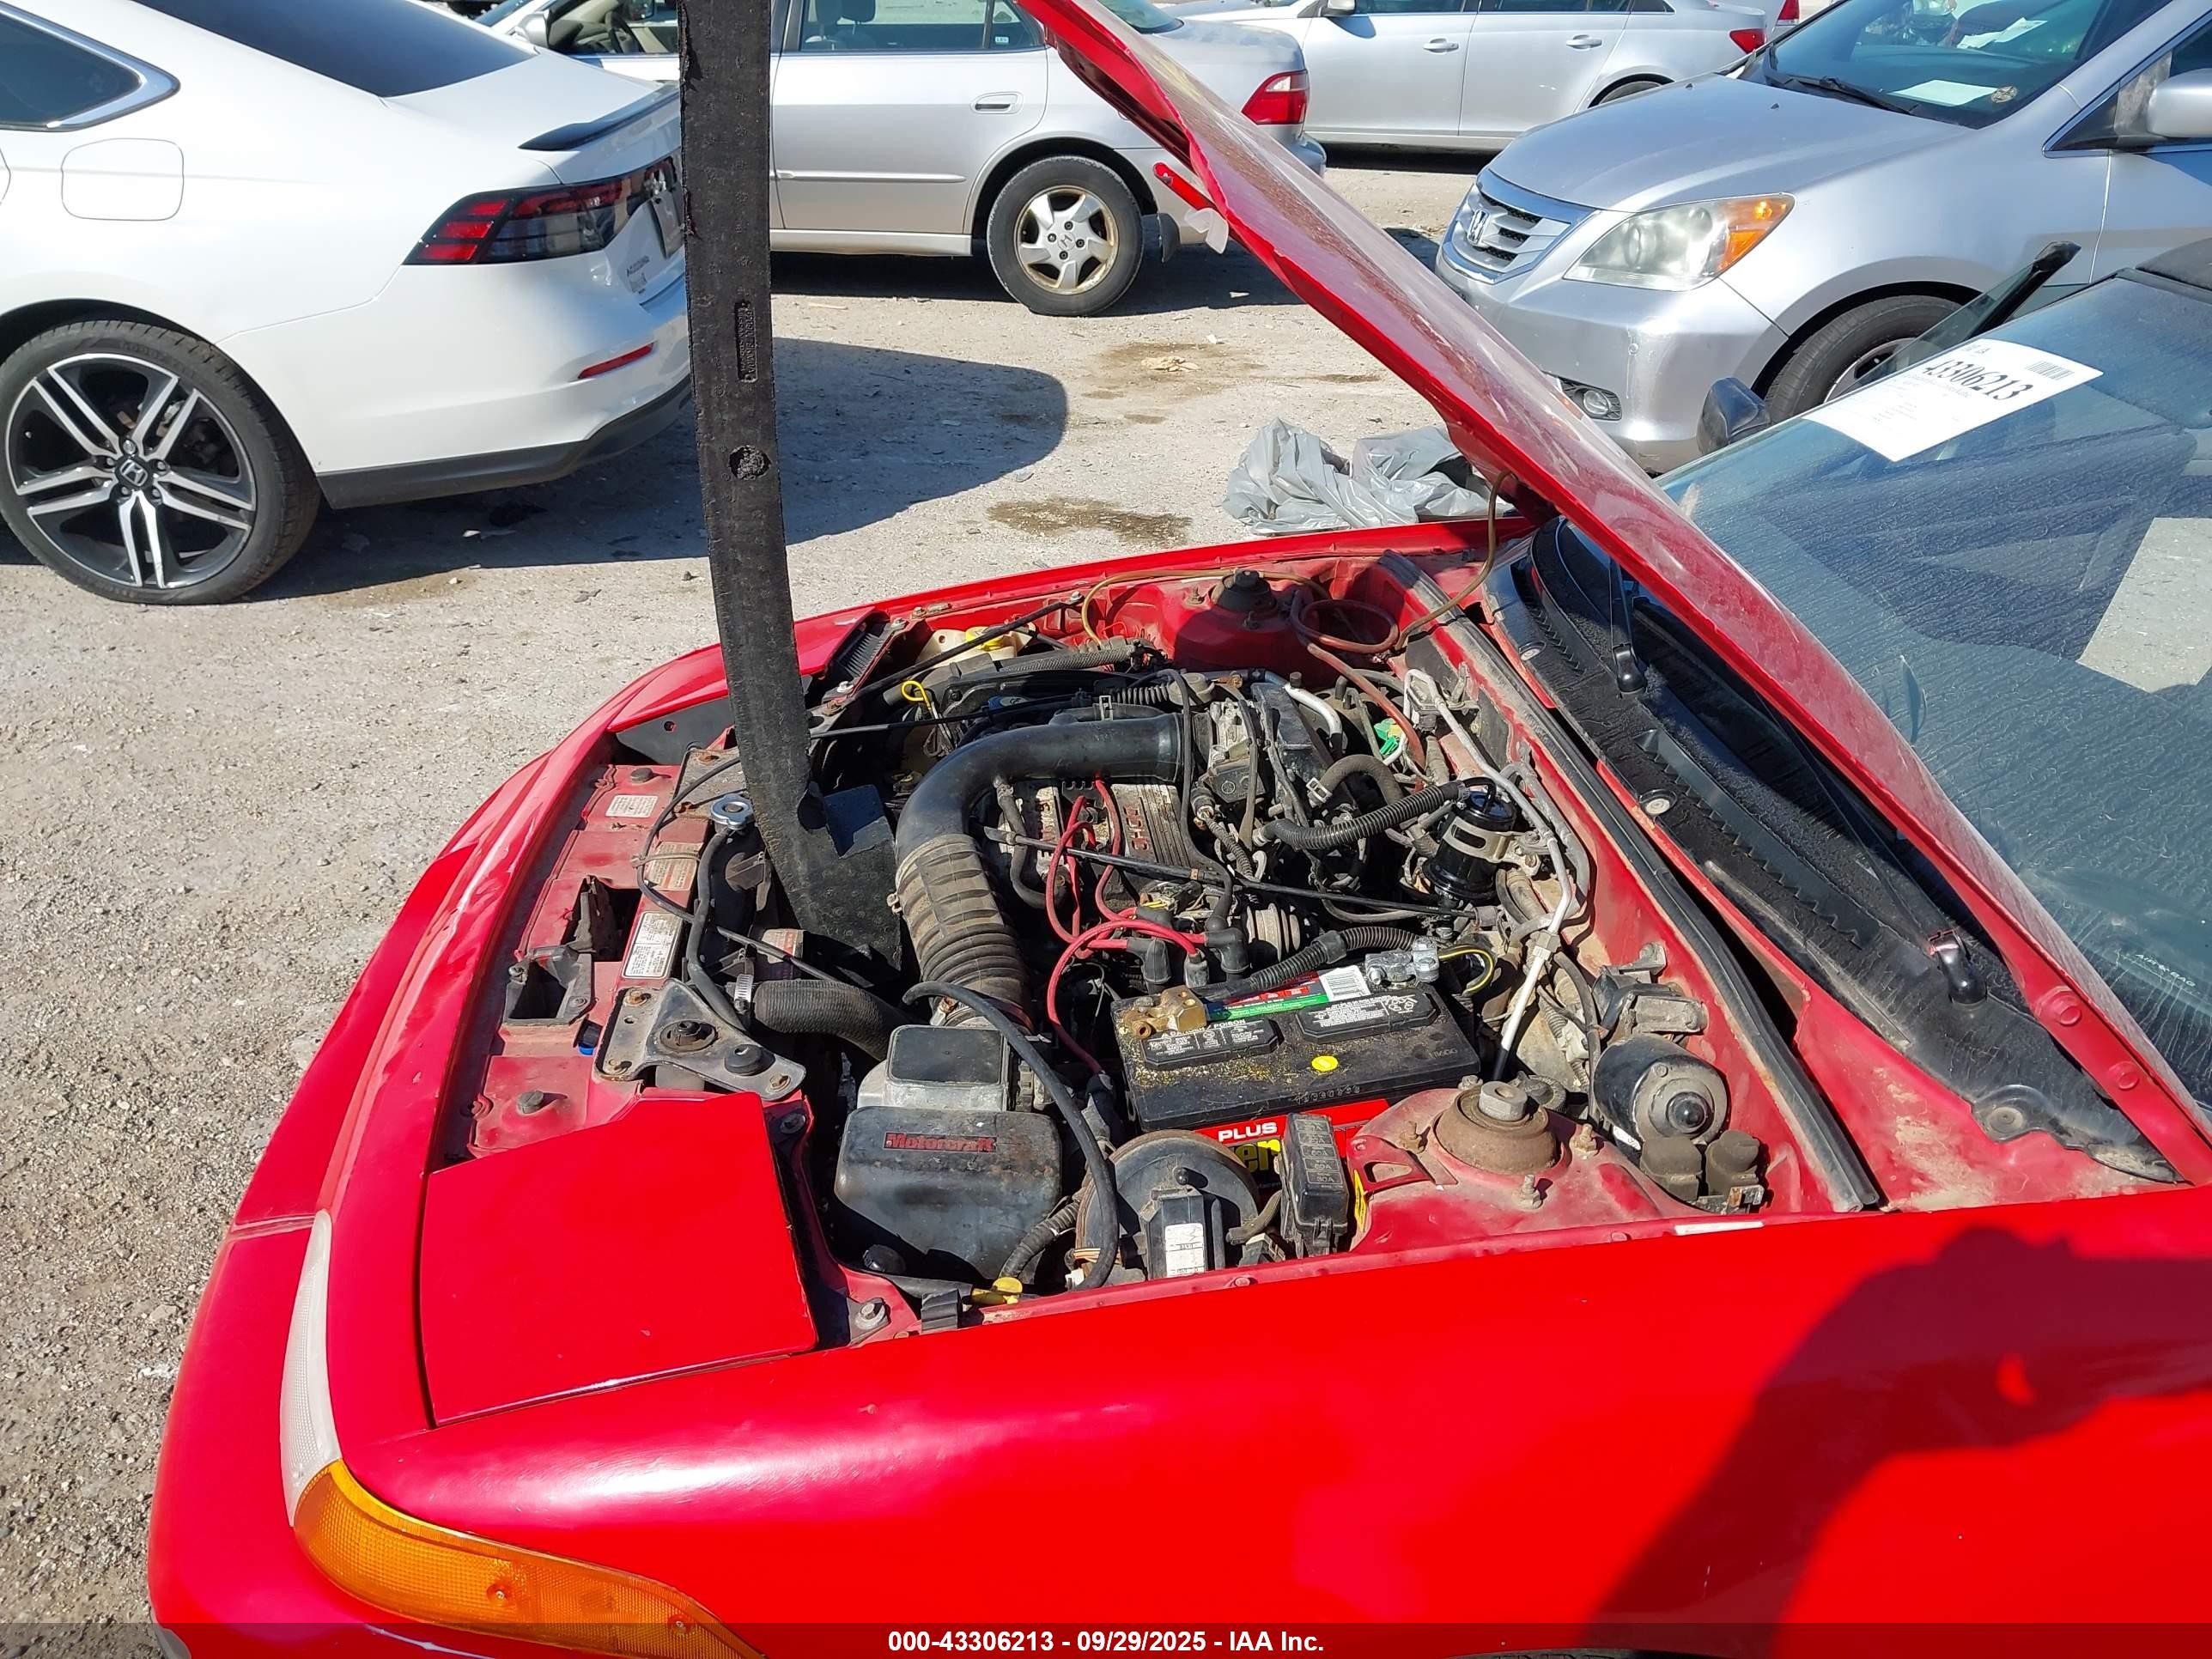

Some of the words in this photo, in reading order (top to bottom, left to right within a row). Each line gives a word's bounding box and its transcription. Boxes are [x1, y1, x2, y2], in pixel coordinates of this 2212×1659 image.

[1922, 359, 2034, 401] 43306213
[886, 1133, 994, 1153] Motorcraft
[1218, 1121, 1278, 1143] PLUS
